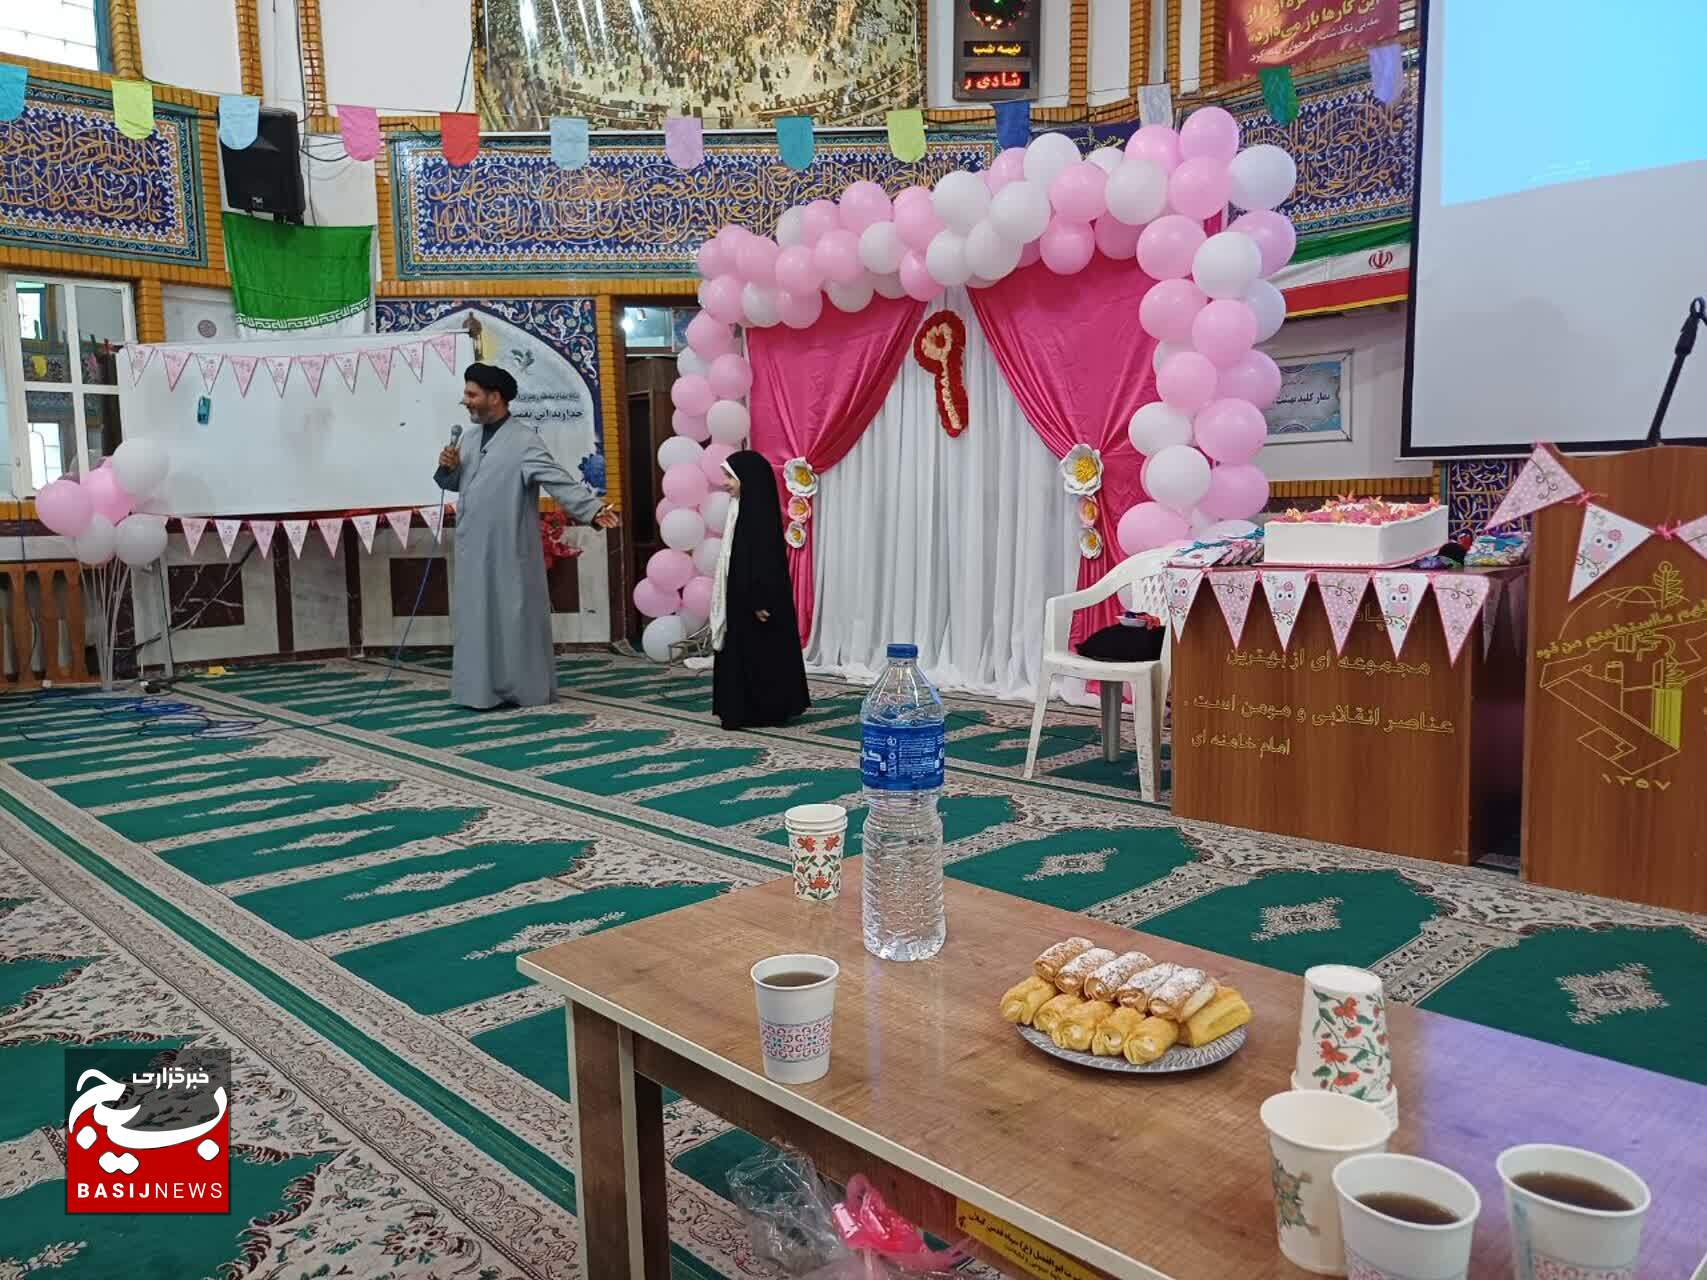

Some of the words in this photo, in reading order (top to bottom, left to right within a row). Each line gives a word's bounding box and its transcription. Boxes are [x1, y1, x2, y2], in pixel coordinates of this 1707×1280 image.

[976, 71, 1021, 90] شادی
[1226, 647, 1287, 671] بهترین
[1296, 707, 1306, 723] و
[1311, 703, 1380, 726] انقلابی
[1384, 711, 1454, 733] عناصر
[1259, 736, 1291, 759] امام
